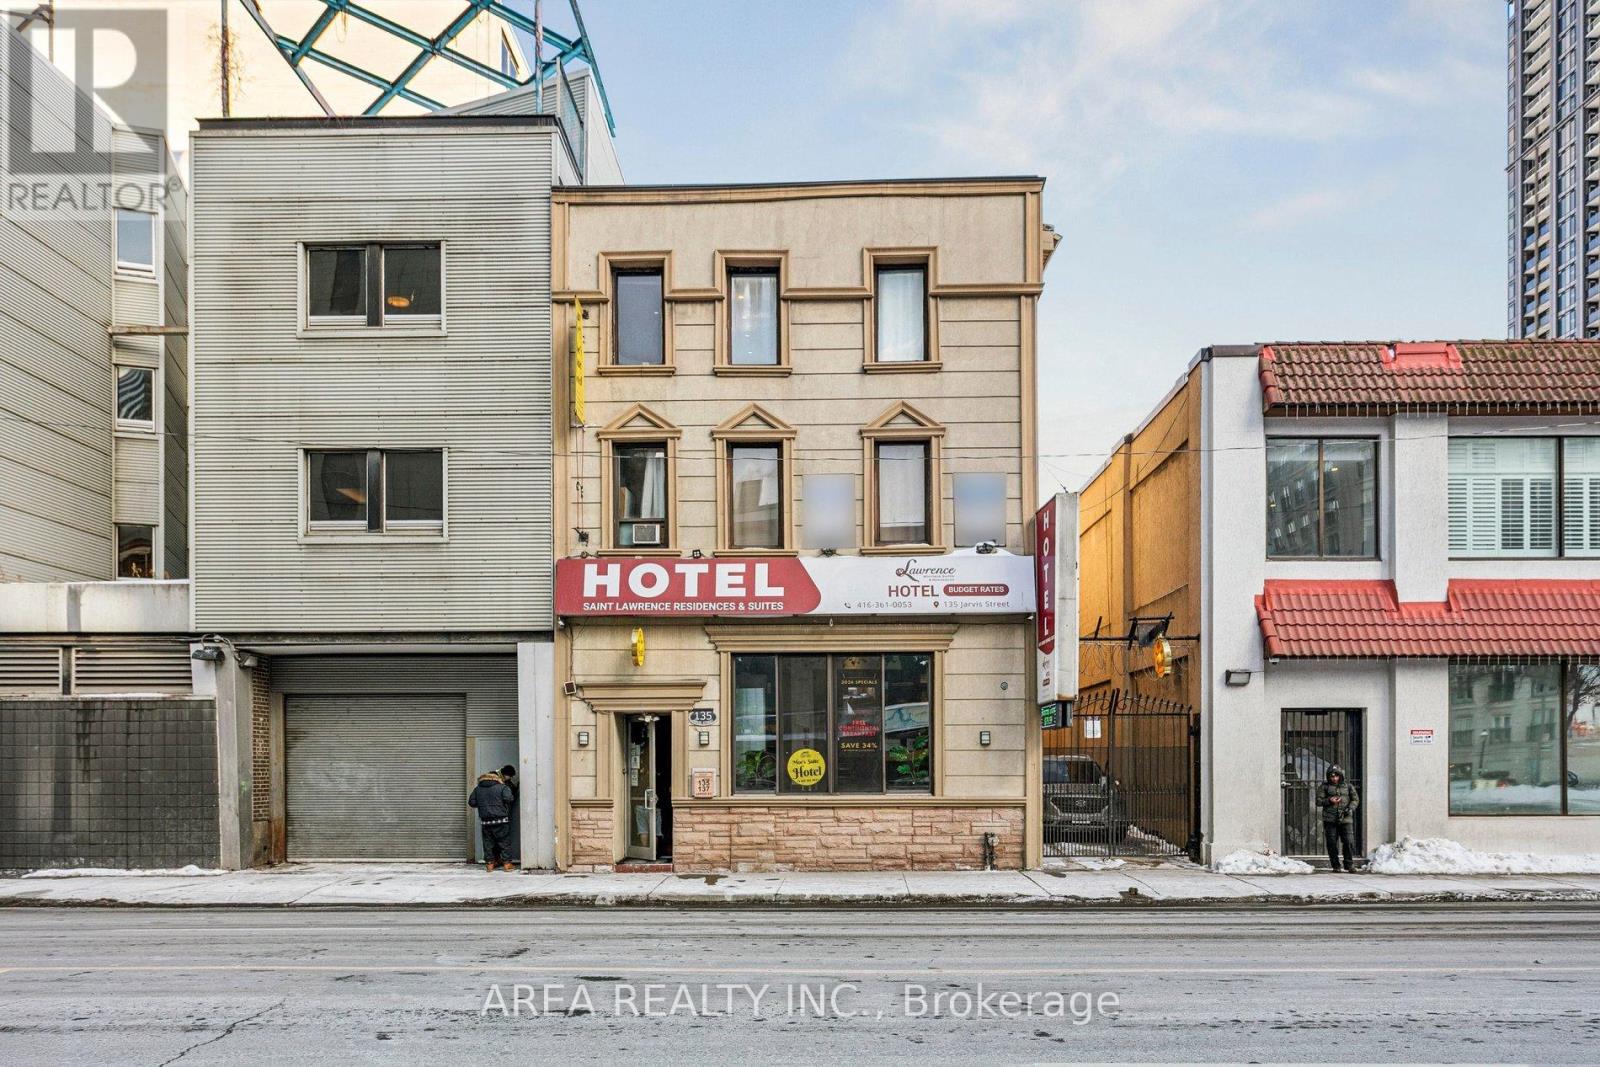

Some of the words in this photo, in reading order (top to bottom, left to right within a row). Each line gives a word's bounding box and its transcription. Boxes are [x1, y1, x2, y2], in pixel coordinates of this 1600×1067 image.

[897, 558, 956, 582] Lawrence
[582, 563, 785, 598] HOTEL
[888, 585, 939, 597] HOTEL
[948, 585, 979, 593] BUDGET
[980, 585, 1005, 593] RATES
[583, 602, 614, 611] SAINT
[616, 602, 671, 611] LAWRENCE
[673, 602, 736, 611] RESIDENCES
[738, 602, 745, 611] &
[748, 602, 784, 611] SUITES
[943, 600, 958, 608] 135
[960, 600, 983, 609] Jarvis
[984, 600, 1010, 608] Street
[694, 711, 713, 721] 135
[792, 766, 822, 779] Hotel
